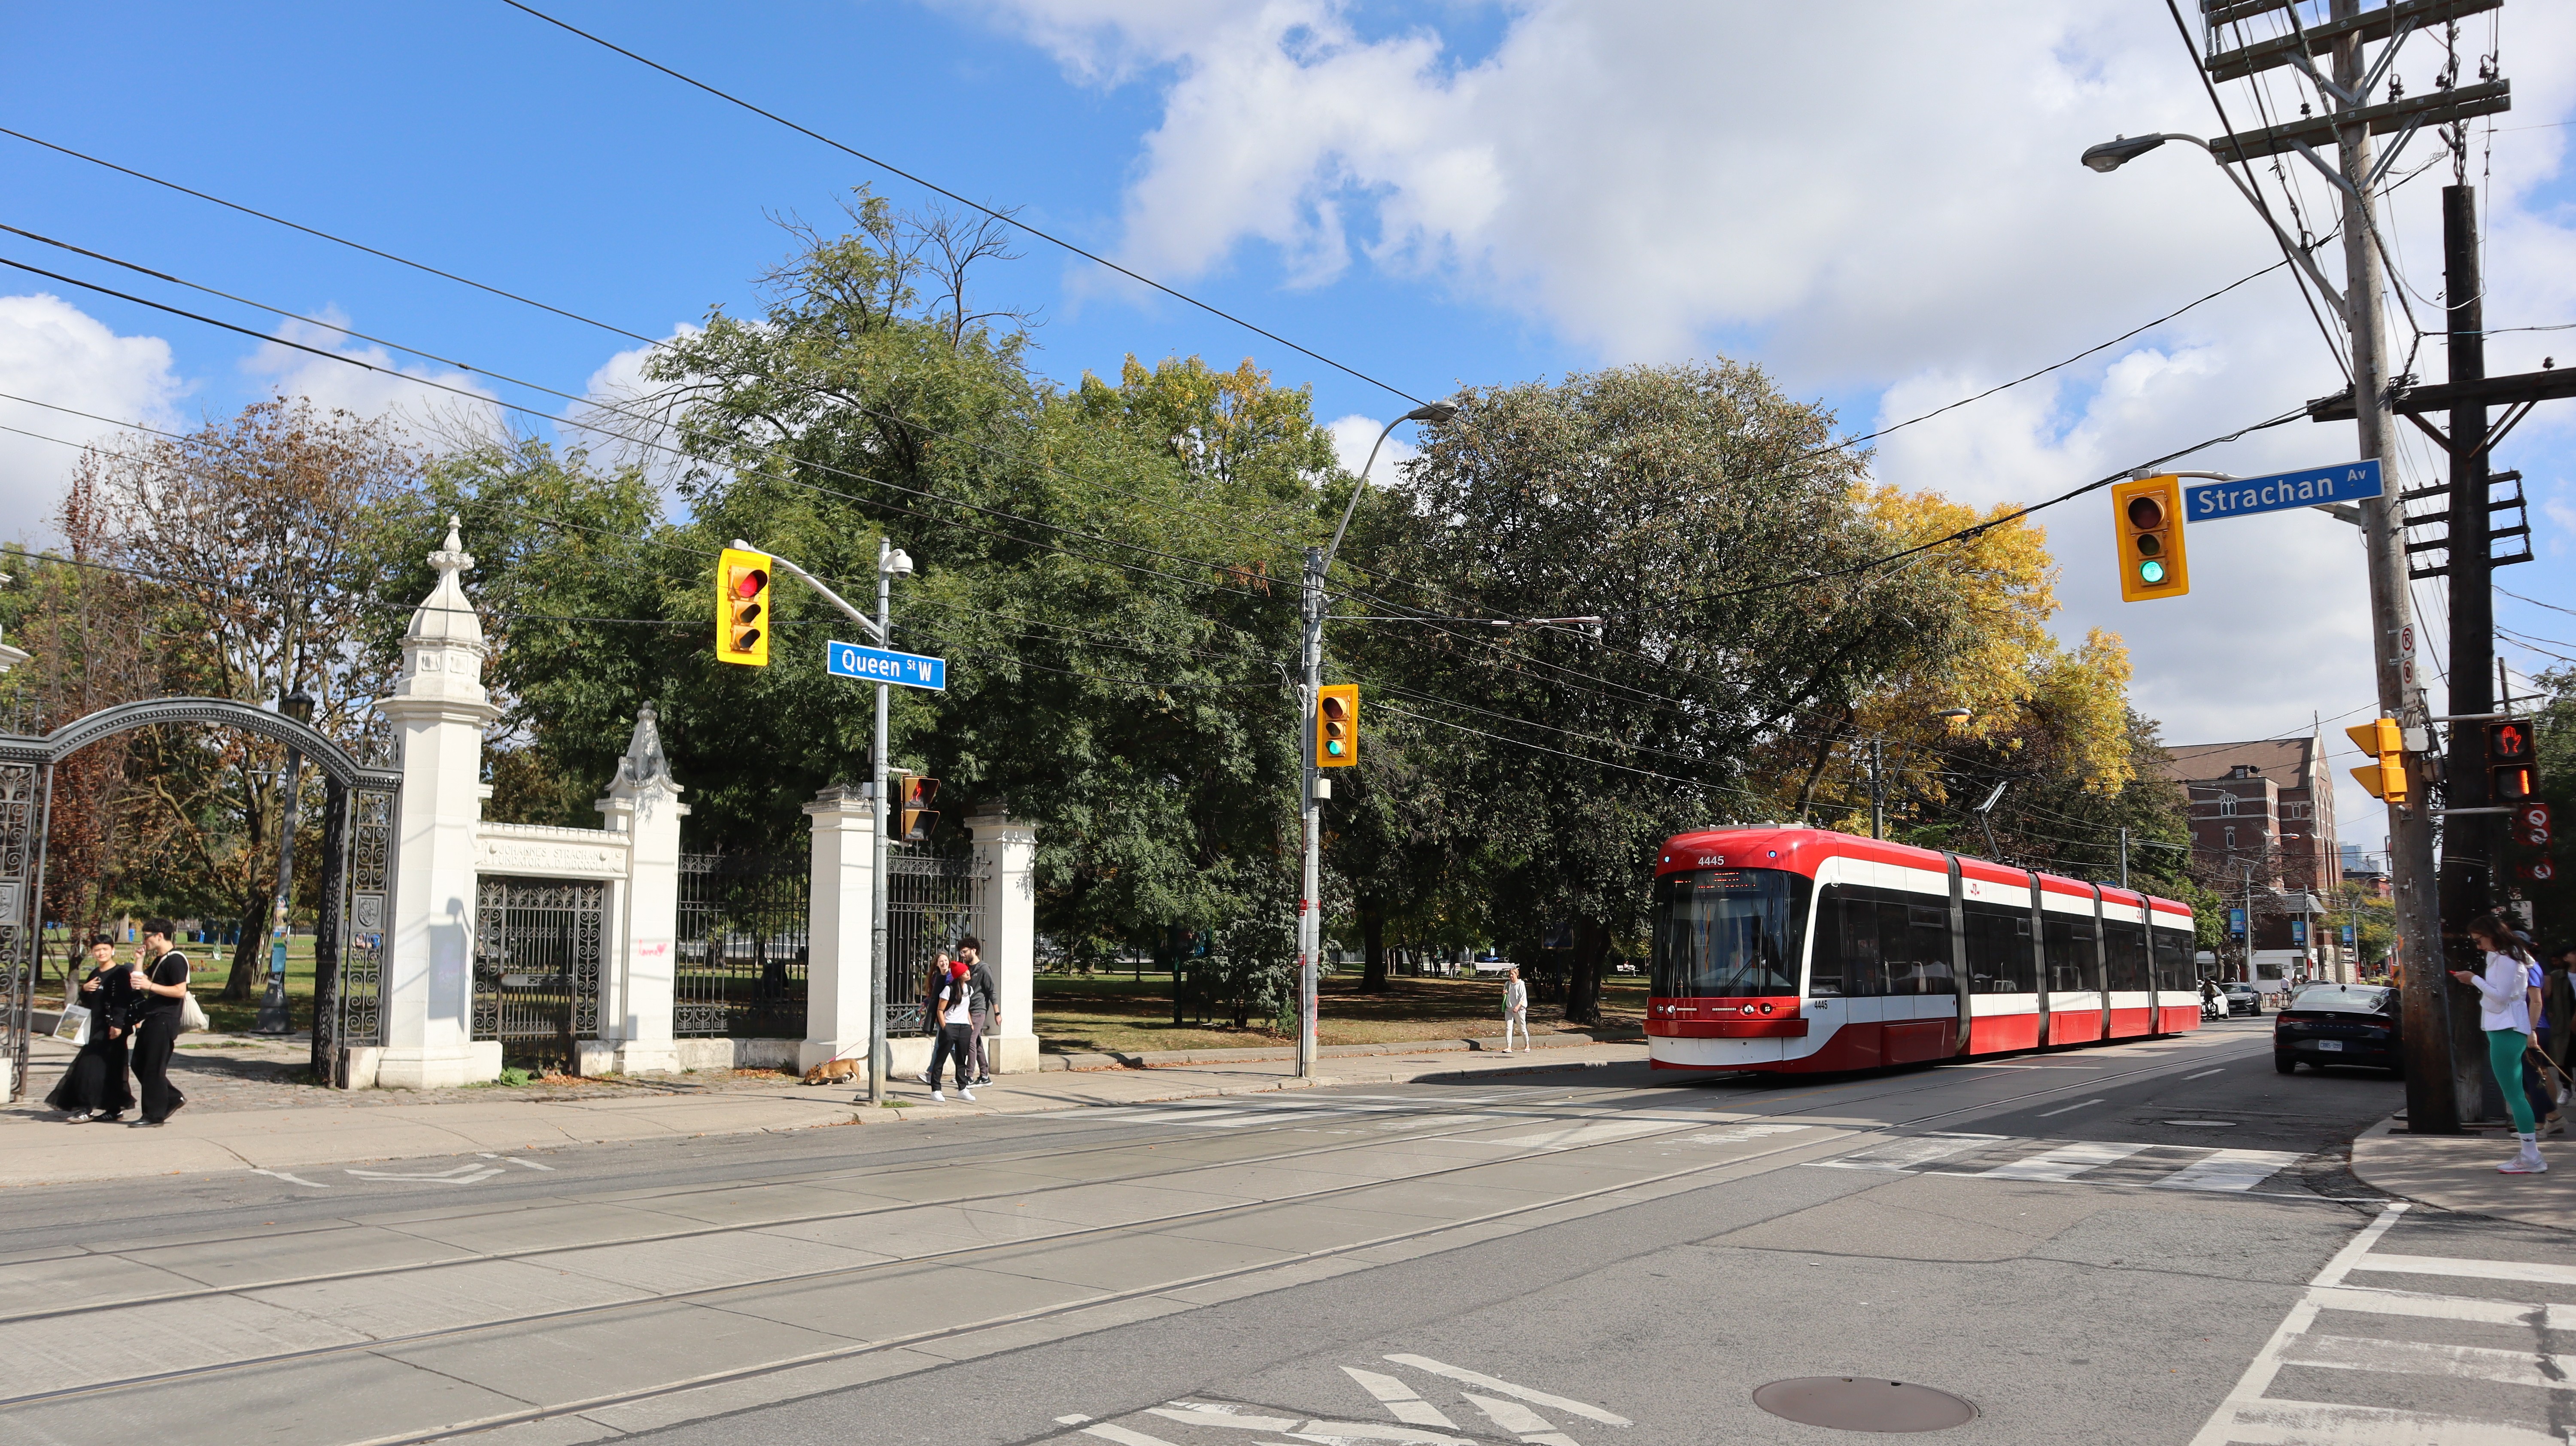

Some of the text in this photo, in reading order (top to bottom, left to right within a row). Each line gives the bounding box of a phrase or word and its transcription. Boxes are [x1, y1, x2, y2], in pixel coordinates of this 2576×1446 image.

[2198, 468, 2366, 513] Strachan Av
[841, 649, 932, 682] Queen St W
[498, 845, 599, 861] JOHANNES STRACHAN
[492, 854, 540, 868] FUNDATOR
[1698, 856, 1724, 866] 4445
[1814, 1000, 1828, 1010] 4445
